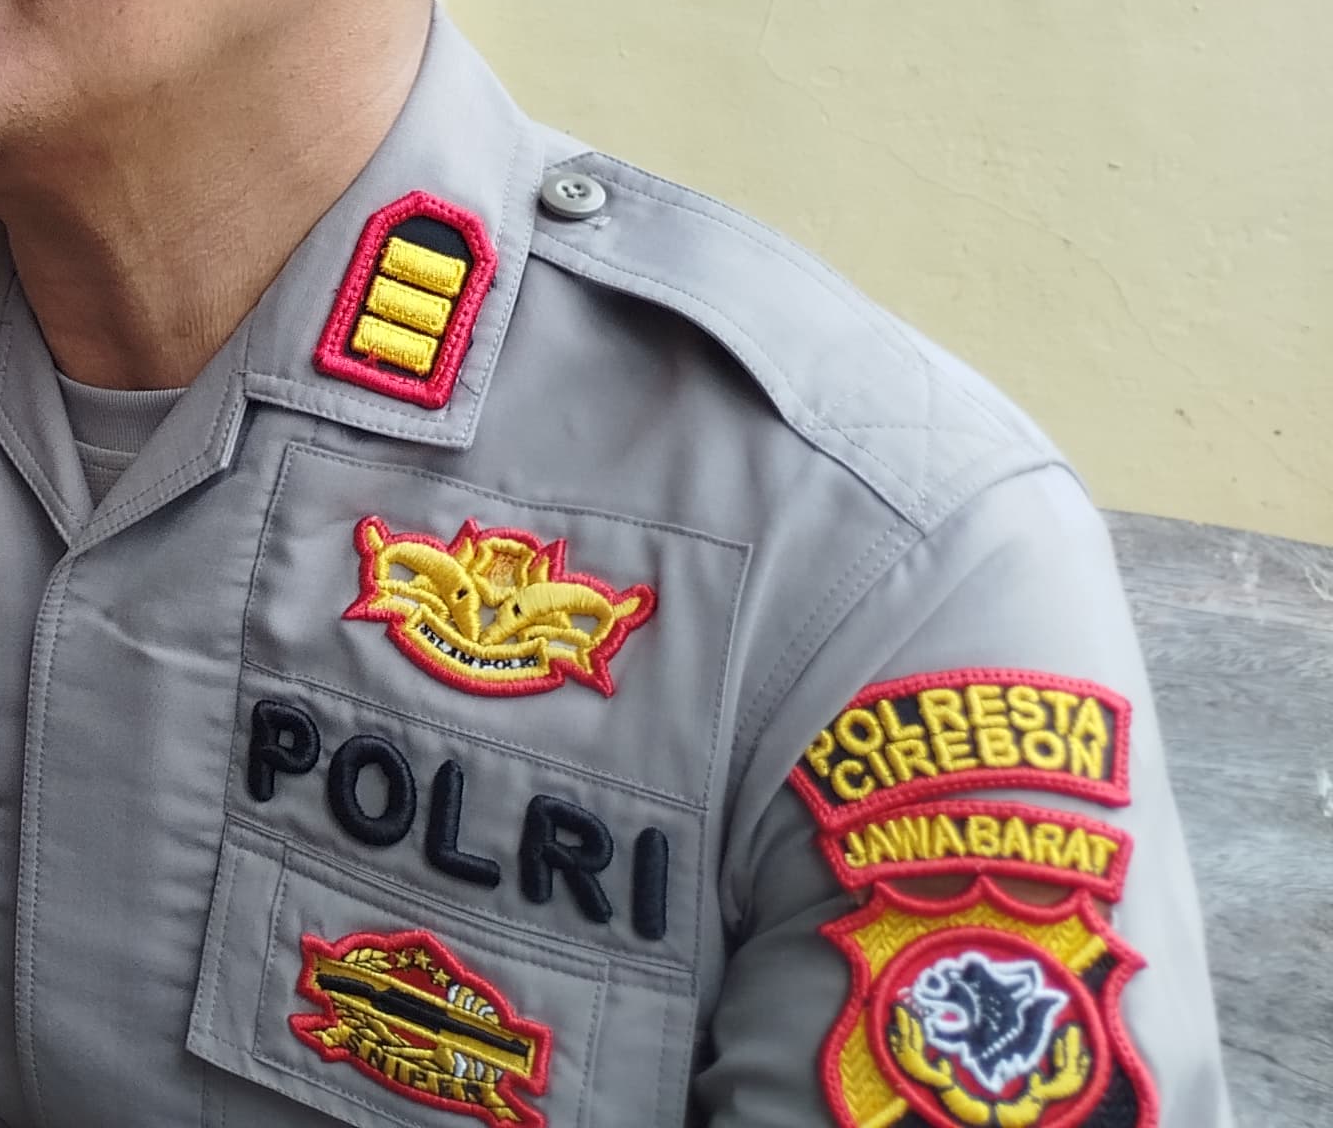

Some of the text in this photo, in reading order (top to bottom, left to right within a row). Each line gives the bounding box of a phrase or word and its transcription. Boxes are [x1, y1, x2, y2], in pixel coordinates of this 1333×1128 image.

[805, 684, 1109, 778] POLRESTA
[830, 727, 1103, 801] CIREBON
[245, 699, 670, 941] POLRI
